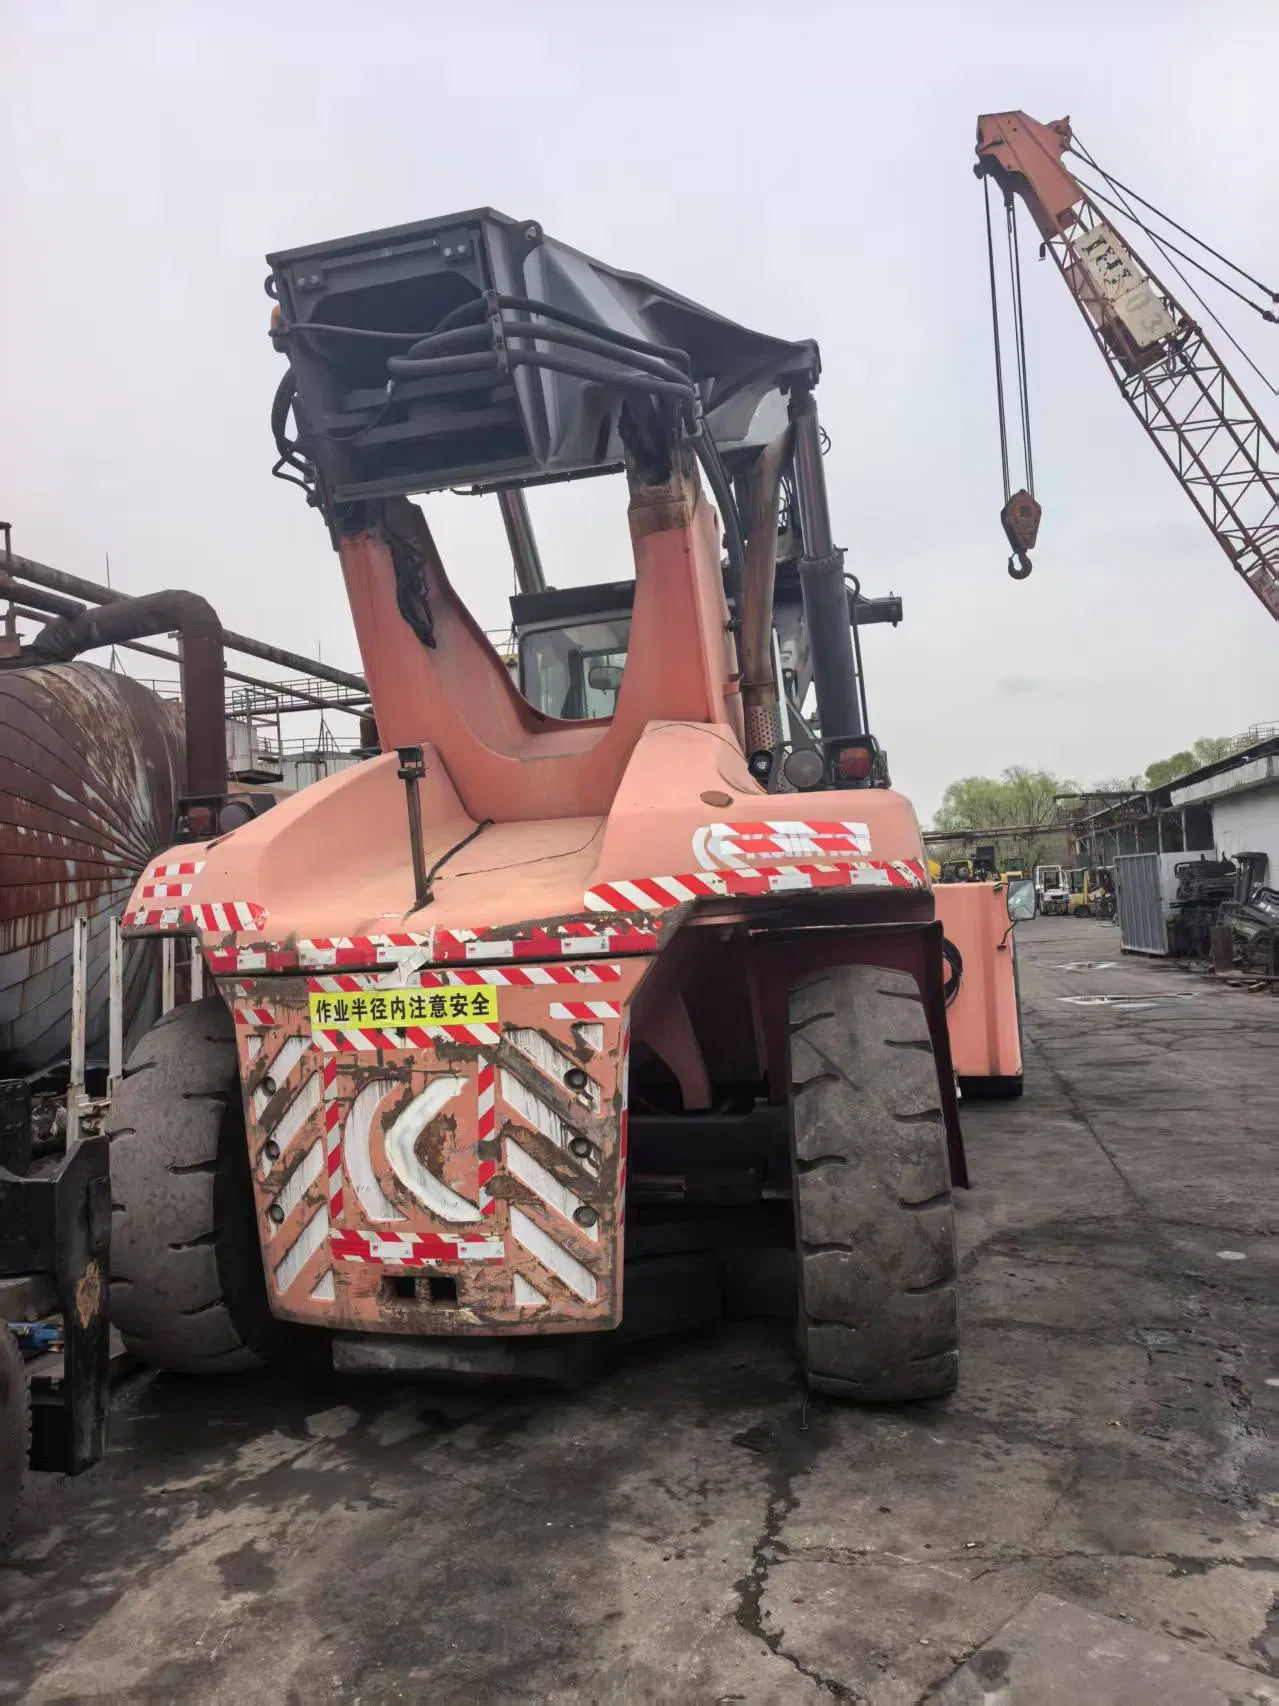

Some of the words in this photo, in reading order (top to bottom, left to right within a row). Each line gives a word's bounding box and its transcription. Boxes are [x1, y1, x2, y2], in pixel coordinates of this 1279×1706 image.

[316, 991, 490, 1024] 作业半径内注意安全
